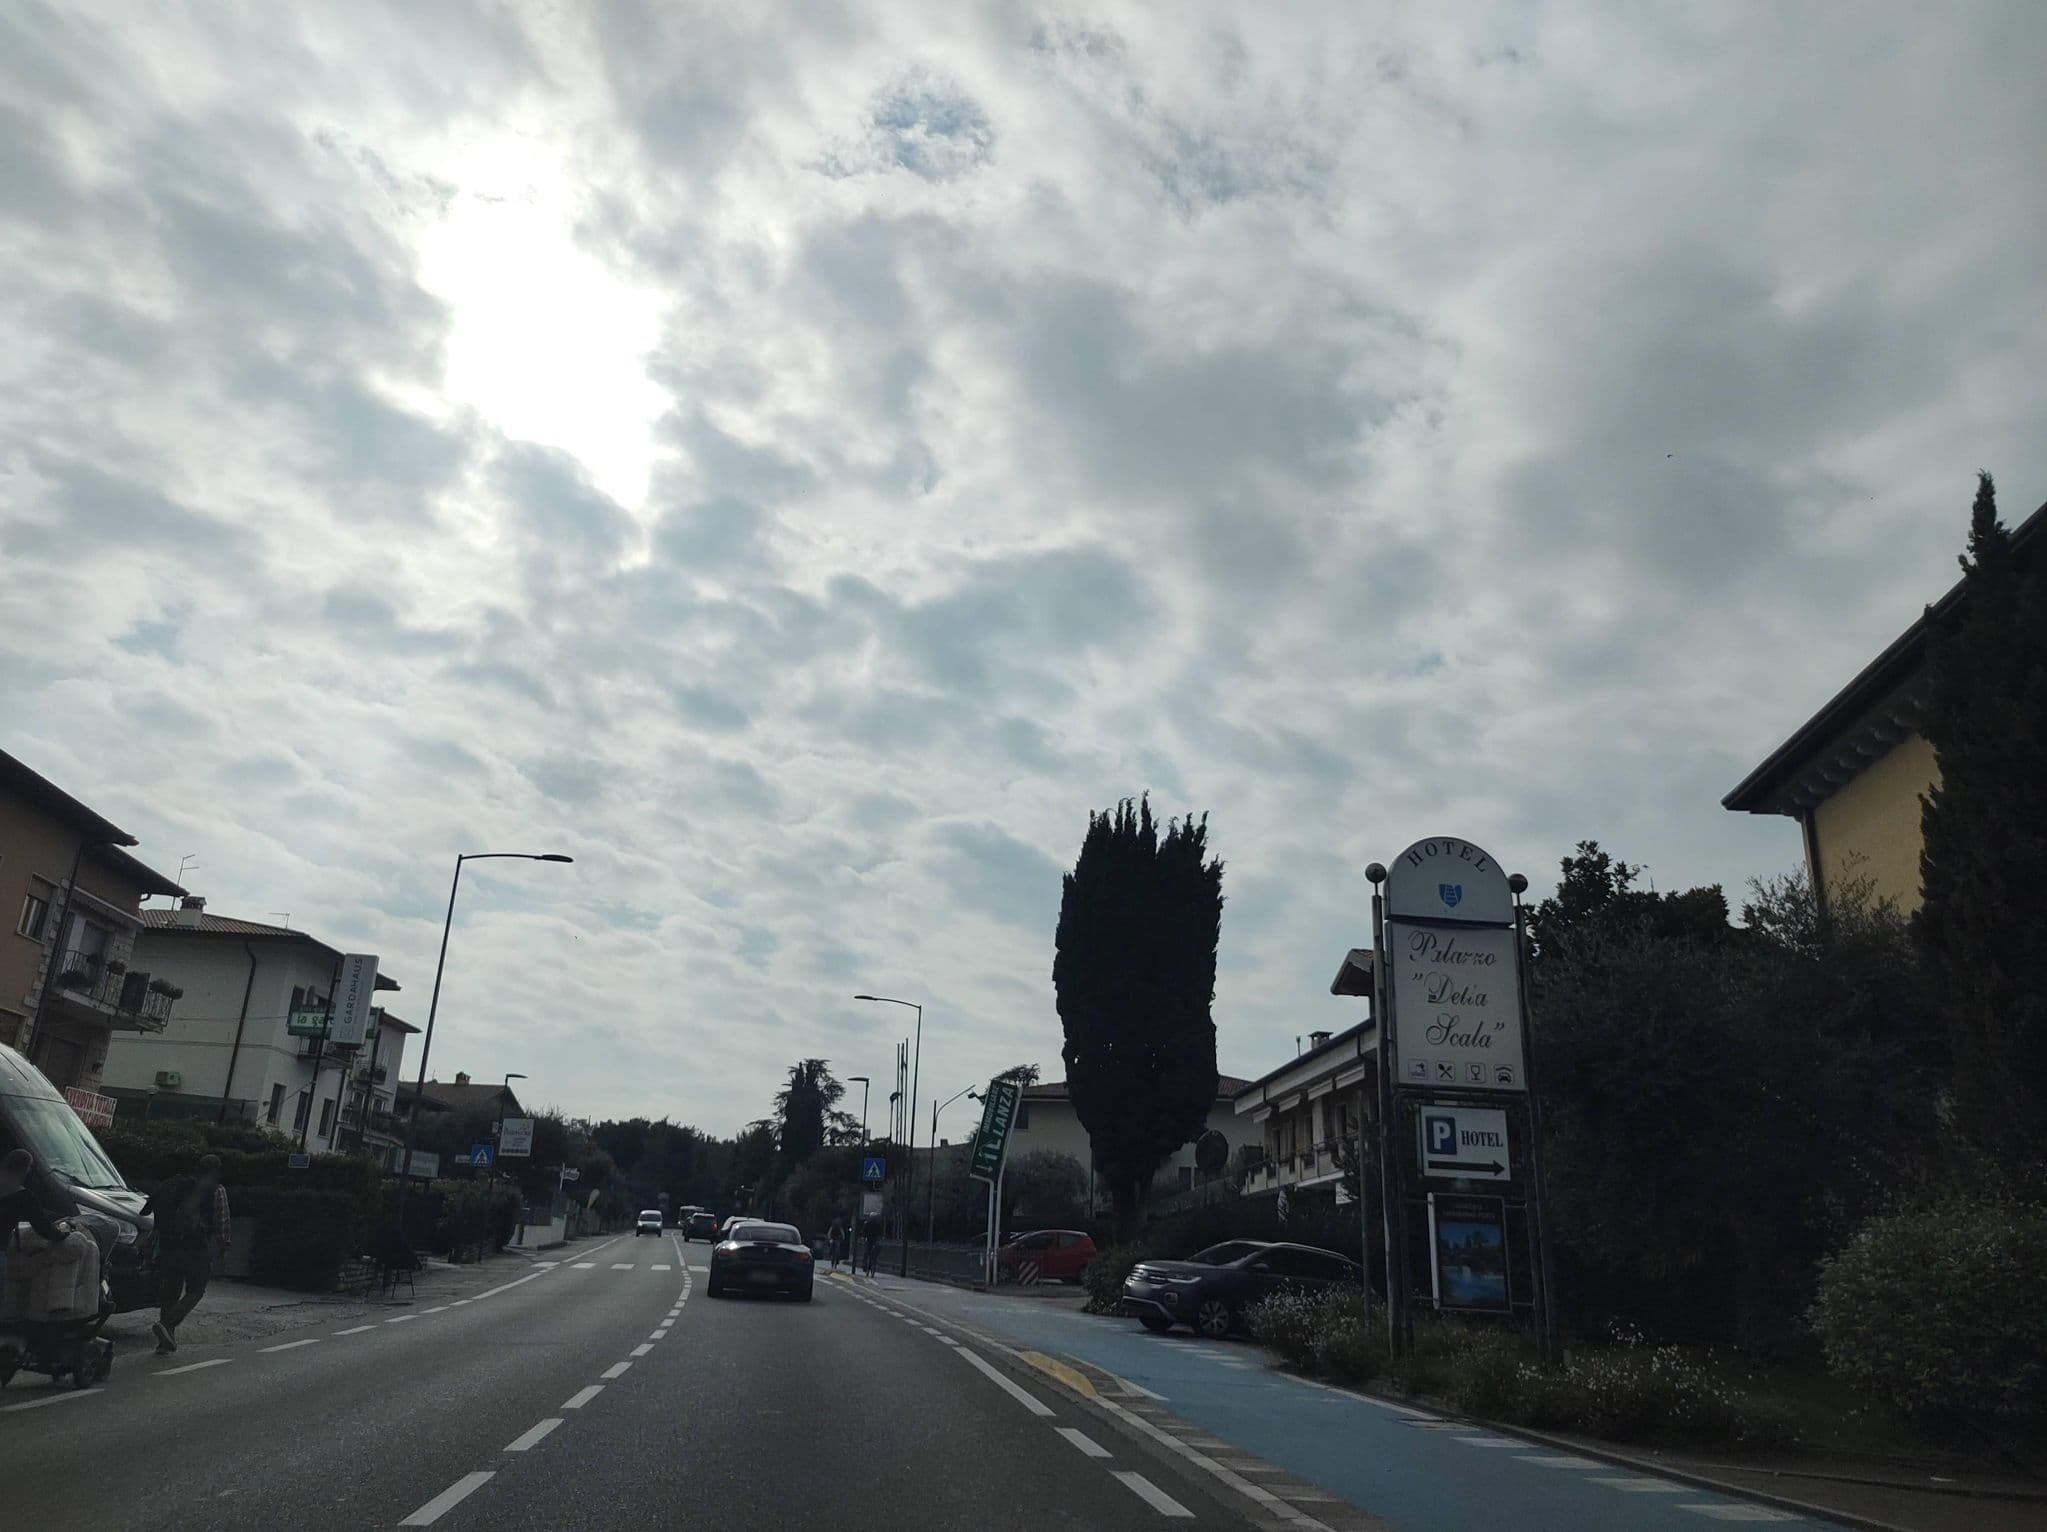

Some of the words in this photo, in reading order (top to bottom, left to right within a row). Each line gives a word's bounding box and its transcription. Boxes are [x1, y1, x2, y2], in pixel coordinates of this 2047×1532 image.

[1407, 841, 1487, 872] HOTEL
[344, 958, 363, 1024] GARDAHAUS
[993, 1087, 1014, 1137] LANZA
[1433, 1121, 1451, 1150] P
[1461, 1130, 1503, 1147] HOTEL
